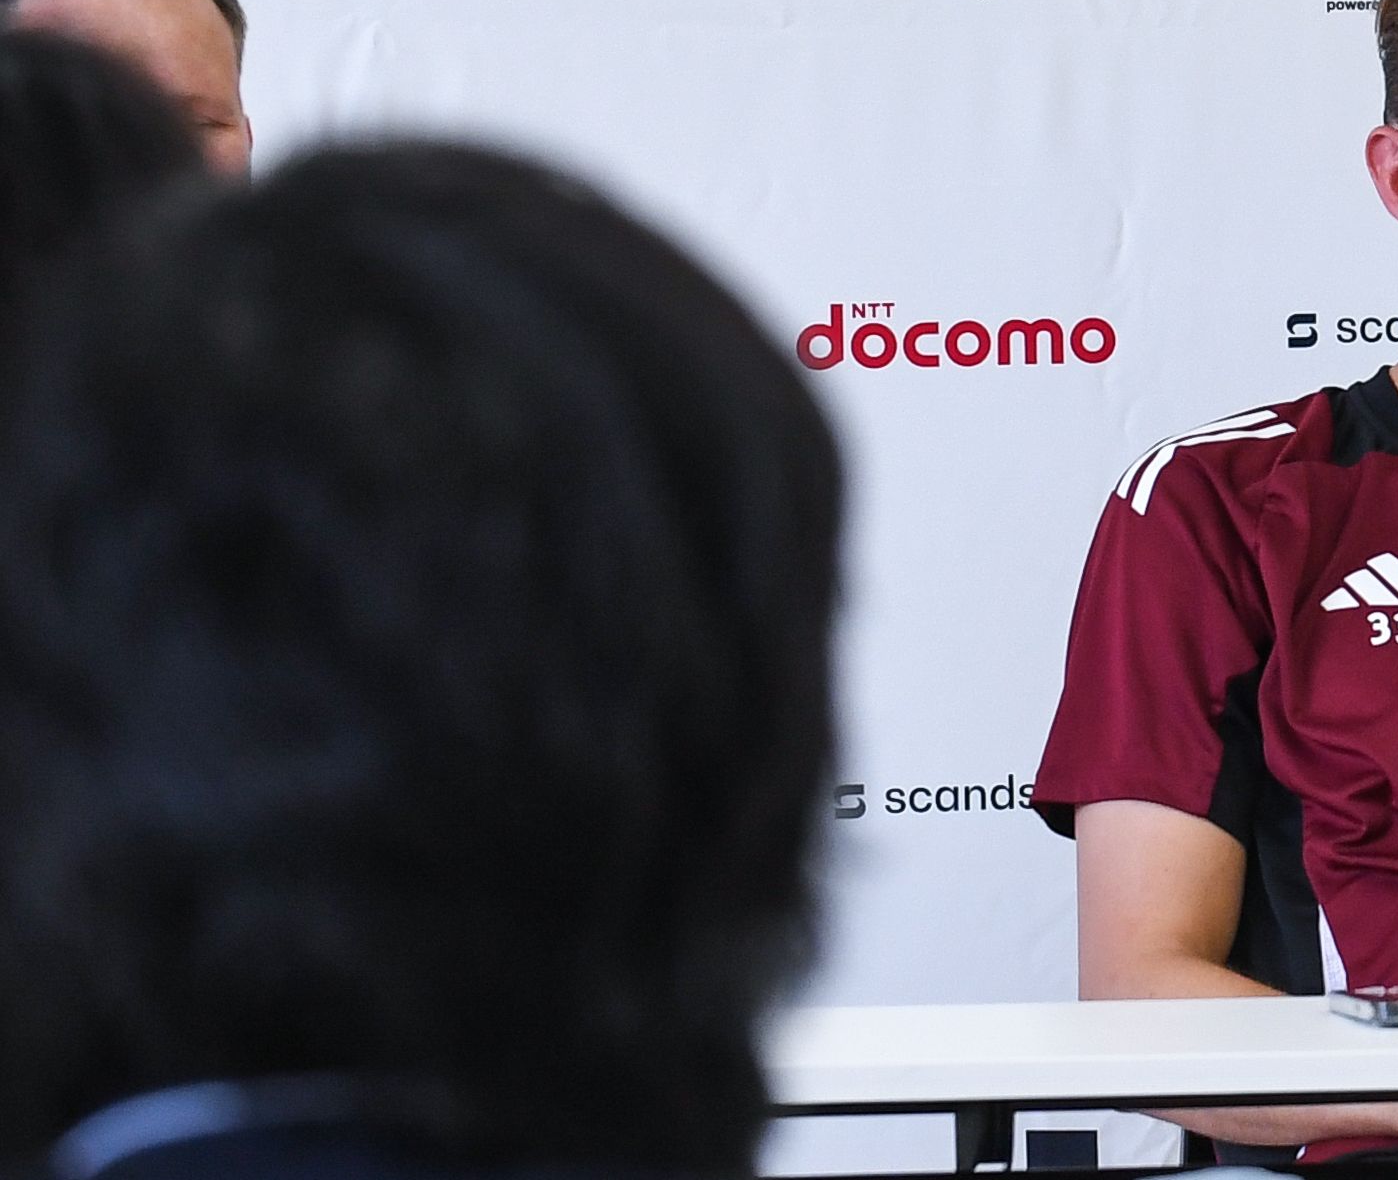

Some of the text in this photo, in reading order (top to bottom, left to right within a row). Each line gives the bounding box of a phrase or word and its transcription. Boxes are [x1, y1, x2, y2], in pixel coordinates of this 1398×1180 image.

[852, 302, 895, 319] NTT
[796, 303, 1117, 371] docomo
[884, 773, 1035, 814] scands
